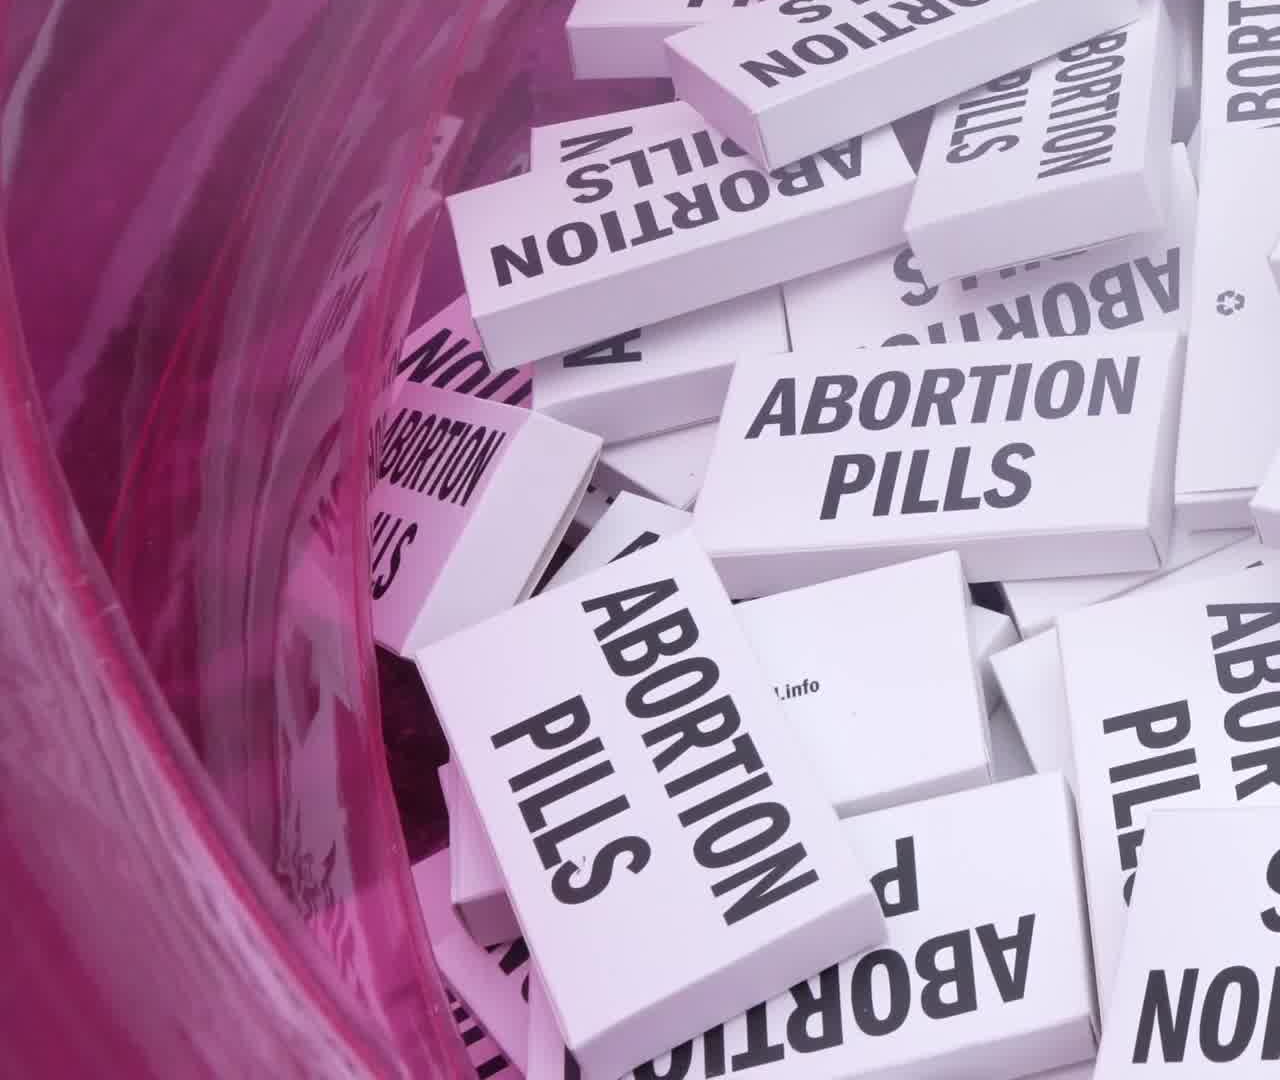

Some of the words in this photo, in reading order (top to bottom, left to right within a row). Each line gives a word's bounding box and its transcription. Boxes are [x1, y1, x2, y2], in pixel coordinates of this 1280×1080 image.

[1037, 30, 1128, 179] BORTION
[490, 133, 865, 288] ABORTION
[744, 356, 1141, 440] ABORTION
[819, 442, 1036, 520] PILLS
[490, 694, 653, 906] PILLS
[581, 577, 822, 927] ABORTION
